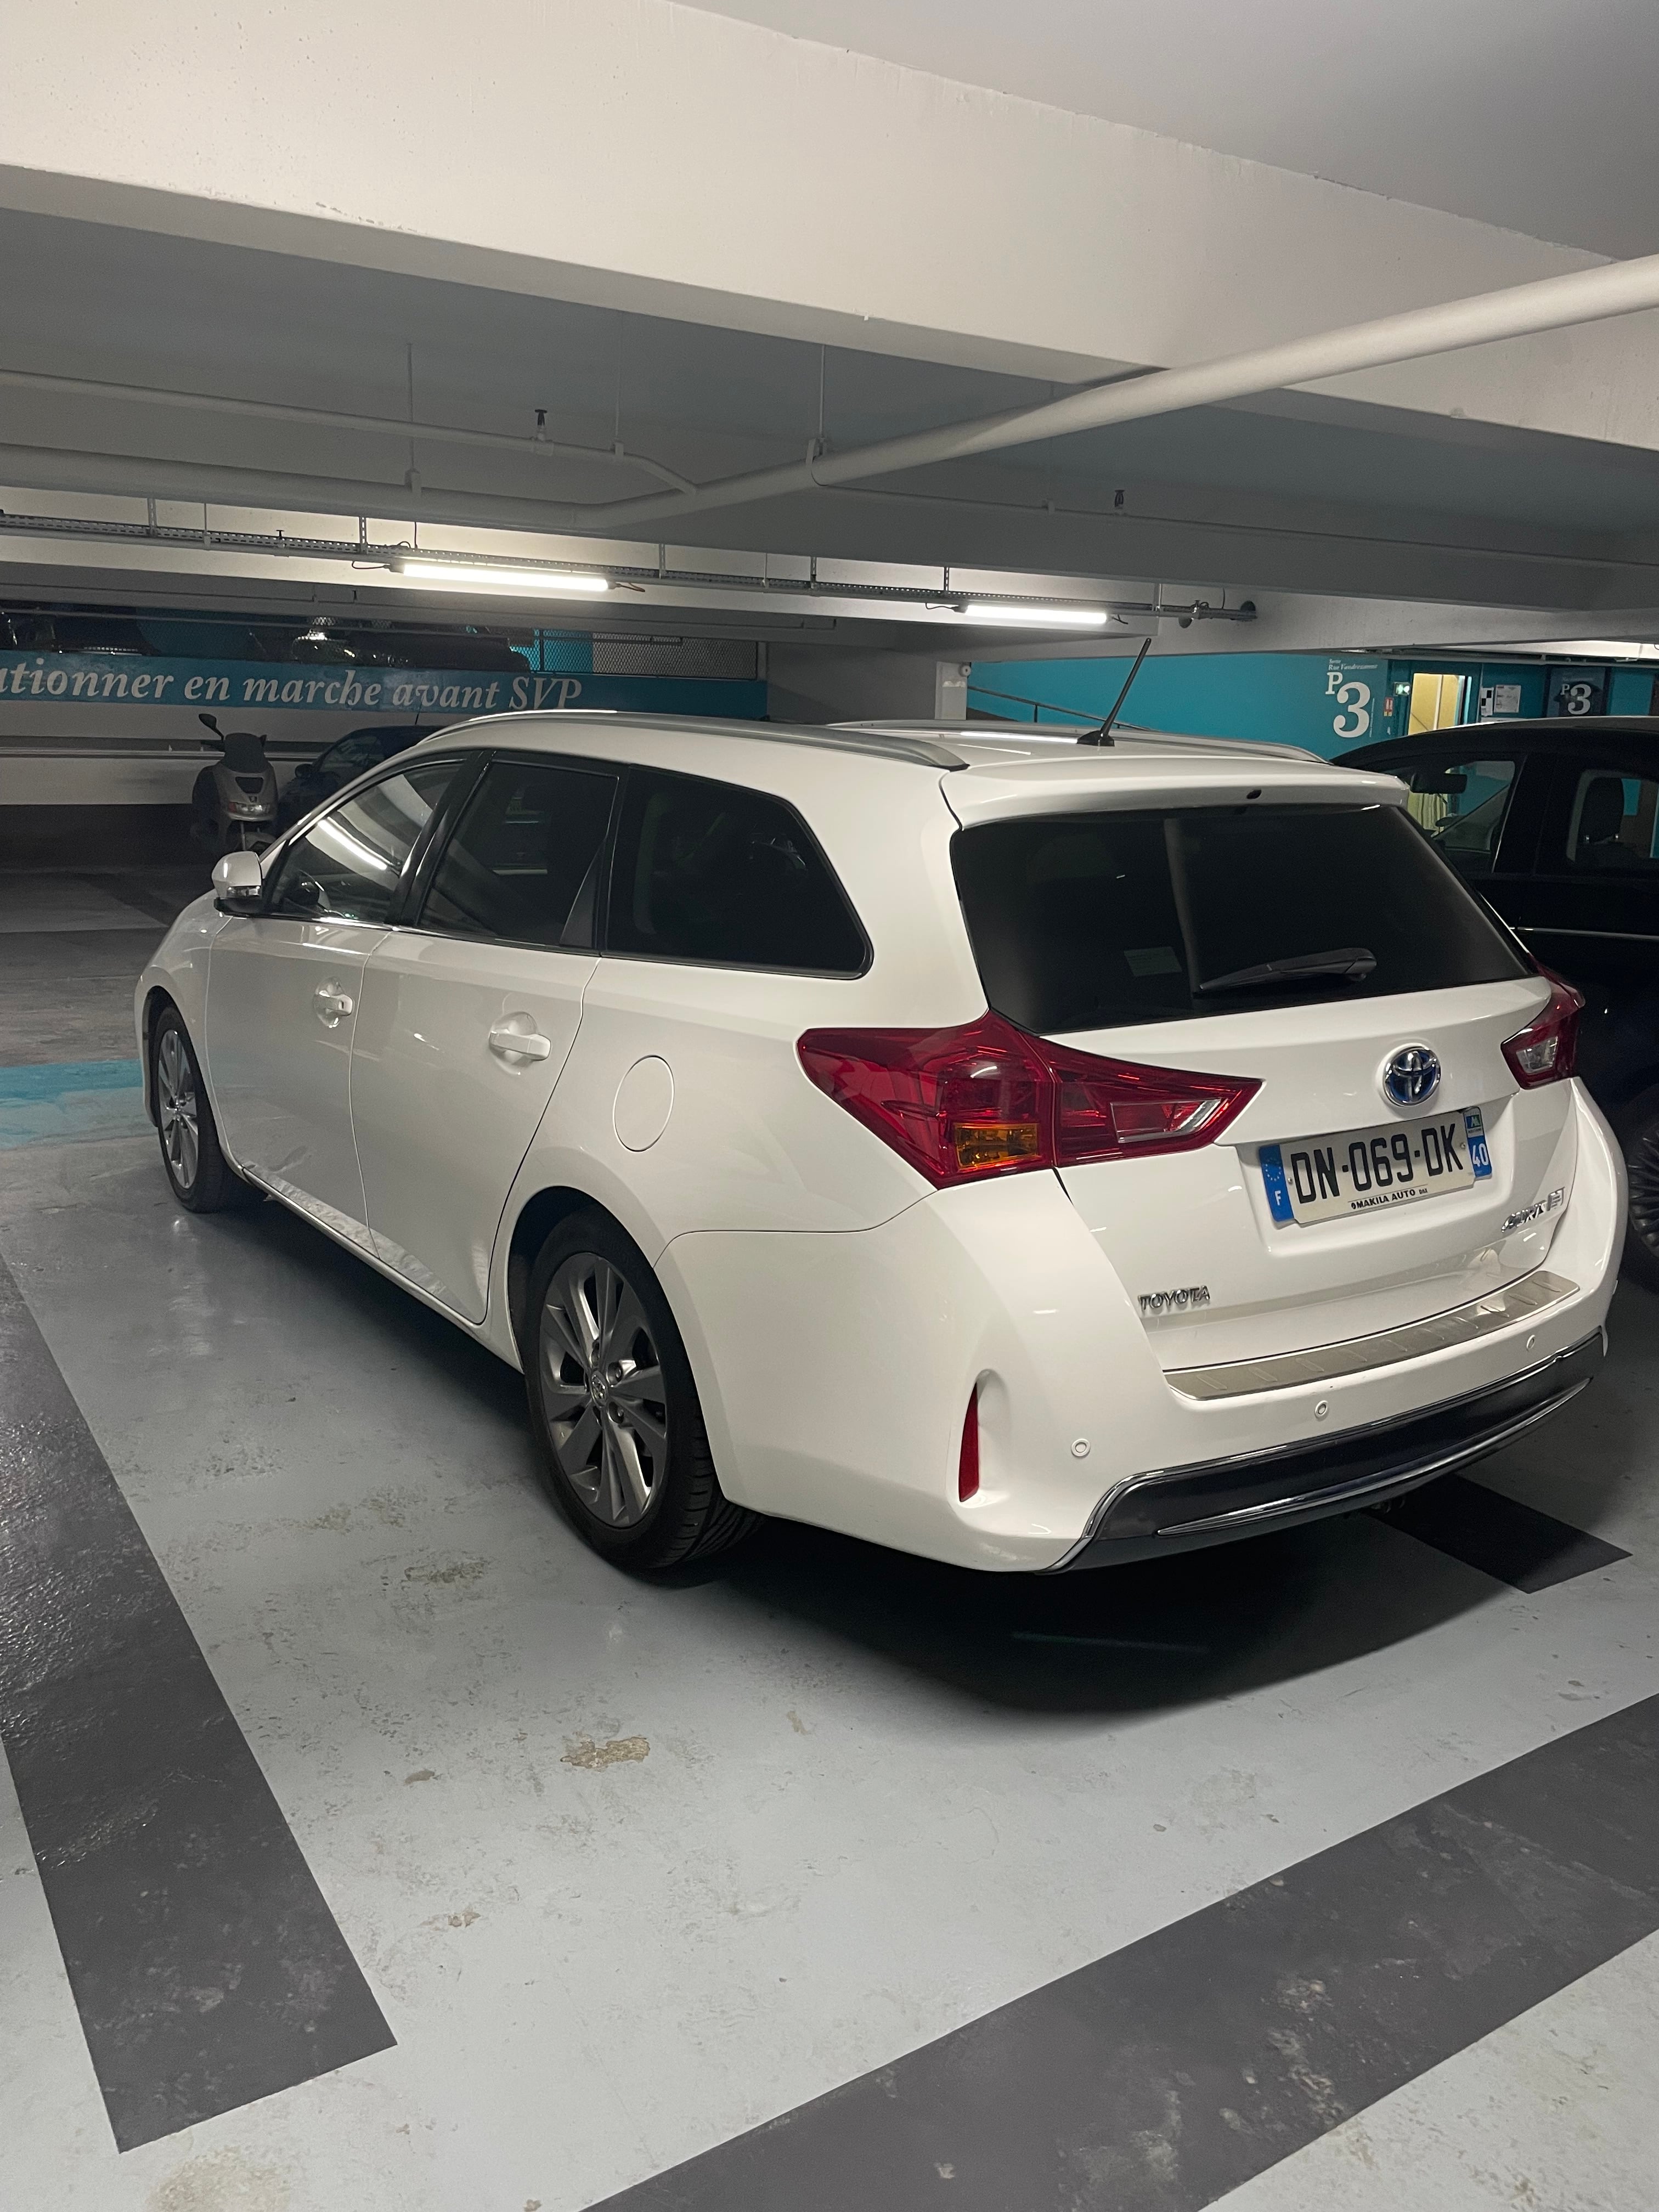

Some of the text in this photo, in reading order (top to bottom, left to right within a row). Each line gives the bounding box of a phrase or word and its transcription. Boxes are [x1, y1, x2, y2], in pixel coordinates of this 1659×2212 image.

[184, 674, 230, 701] en
[242, 669, 380, 706] marche
[392, 679, 501, 709] avant
[507, 676, 582, 710] SVP
[1290, 1123, 1464, 1204] DN-069-DK
[1472, 1143, 1489, 1167] 40
[1274, 1190, 1282, 1206] F
[1391, 1189, 1416, 1201] AUTO
[1137, 1285, 1211, 1310] TOYOTA
